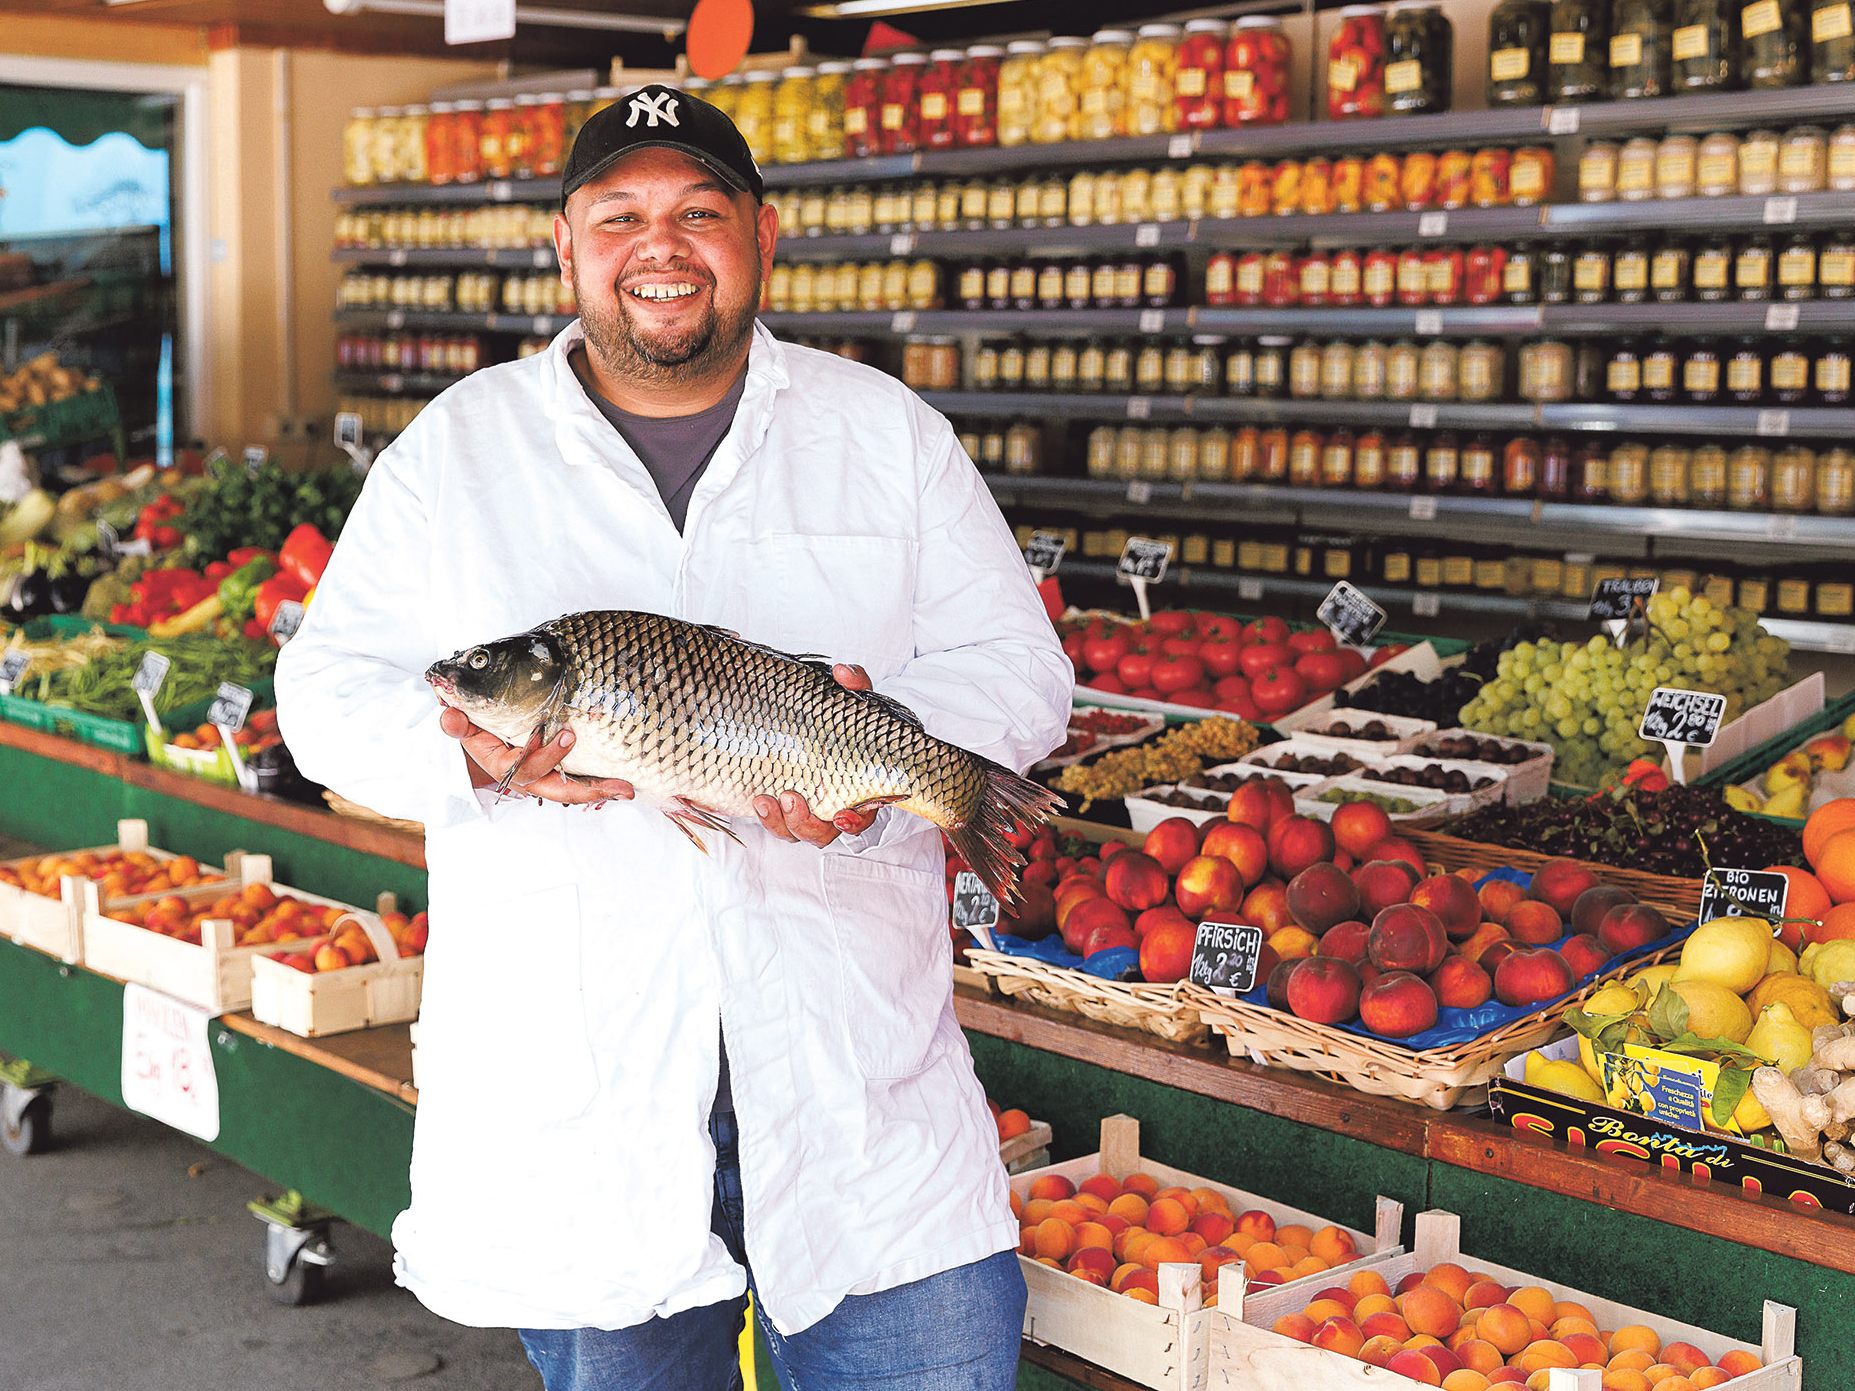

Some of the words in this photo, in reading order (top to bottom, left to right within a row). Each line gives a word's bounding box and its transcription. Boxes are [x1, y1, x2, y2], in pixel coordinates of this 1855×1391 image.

[625, 92, 680, 128] NY
[1651, 691, 1719, 717] WEICHSEL
[1661, 1085, 1695, 1100] Freschezza
[1588, 1116, 1704, 1159] Bontà
[1705, 1150, 1735, 1168] di
